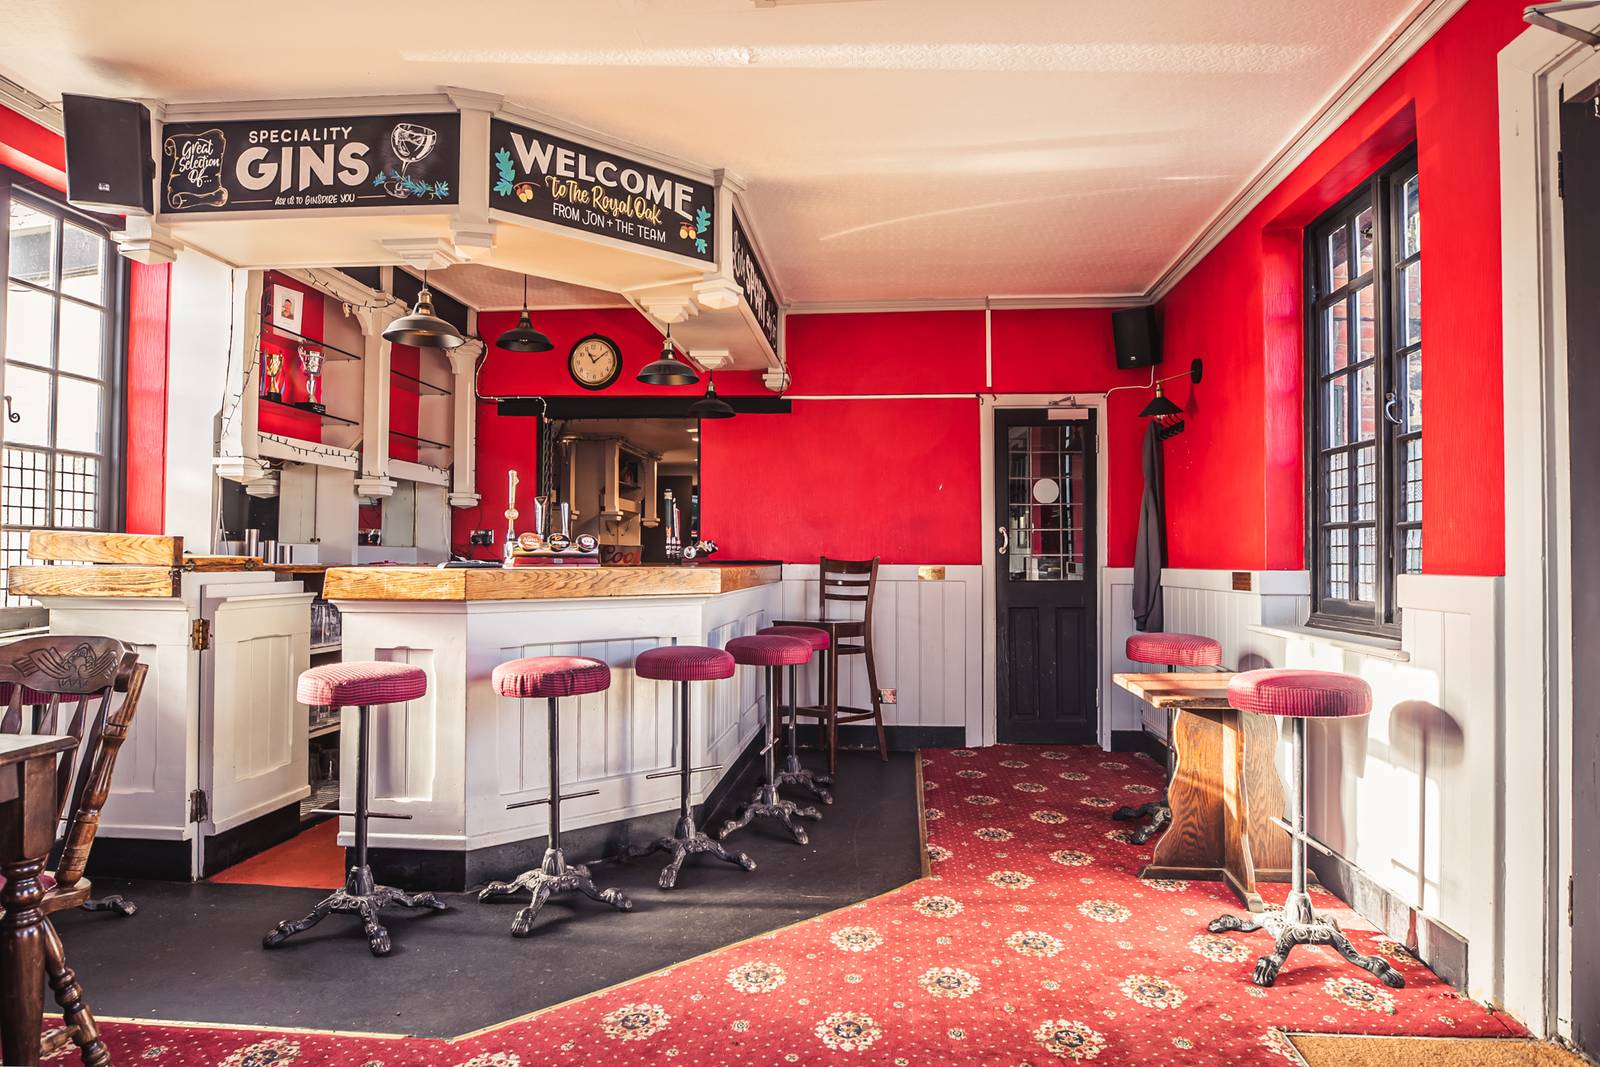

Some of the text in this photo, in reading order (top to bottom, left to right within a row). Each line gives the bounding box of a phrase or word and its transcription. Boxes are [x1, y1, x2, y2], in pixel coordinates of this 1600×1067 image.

[182, 138, 214, 160] Great
[248, 126, 353, 144] SPECIALITY
[178, 154, 220, 173] Selection
[235, 141, 370, 193] GINS
[510, 131, 694, 222] WELCOME
[296, 196, 304, 205] TO
[304, 194, 338, 206] GINSPIRE
[340, 193, 356, 203] YOU
[565, 179, 590, 205] The
[591, 185, 634, 218] Royal
[633, 196, 663, 225] Oak
[553, 202, 580, 222] FROM
[582, 209, 605, 229] JON
[615, 218, 634, 236] THE
[637, 224, 666, 243] TEAM
[745, 253, 767, 328] SPORT
